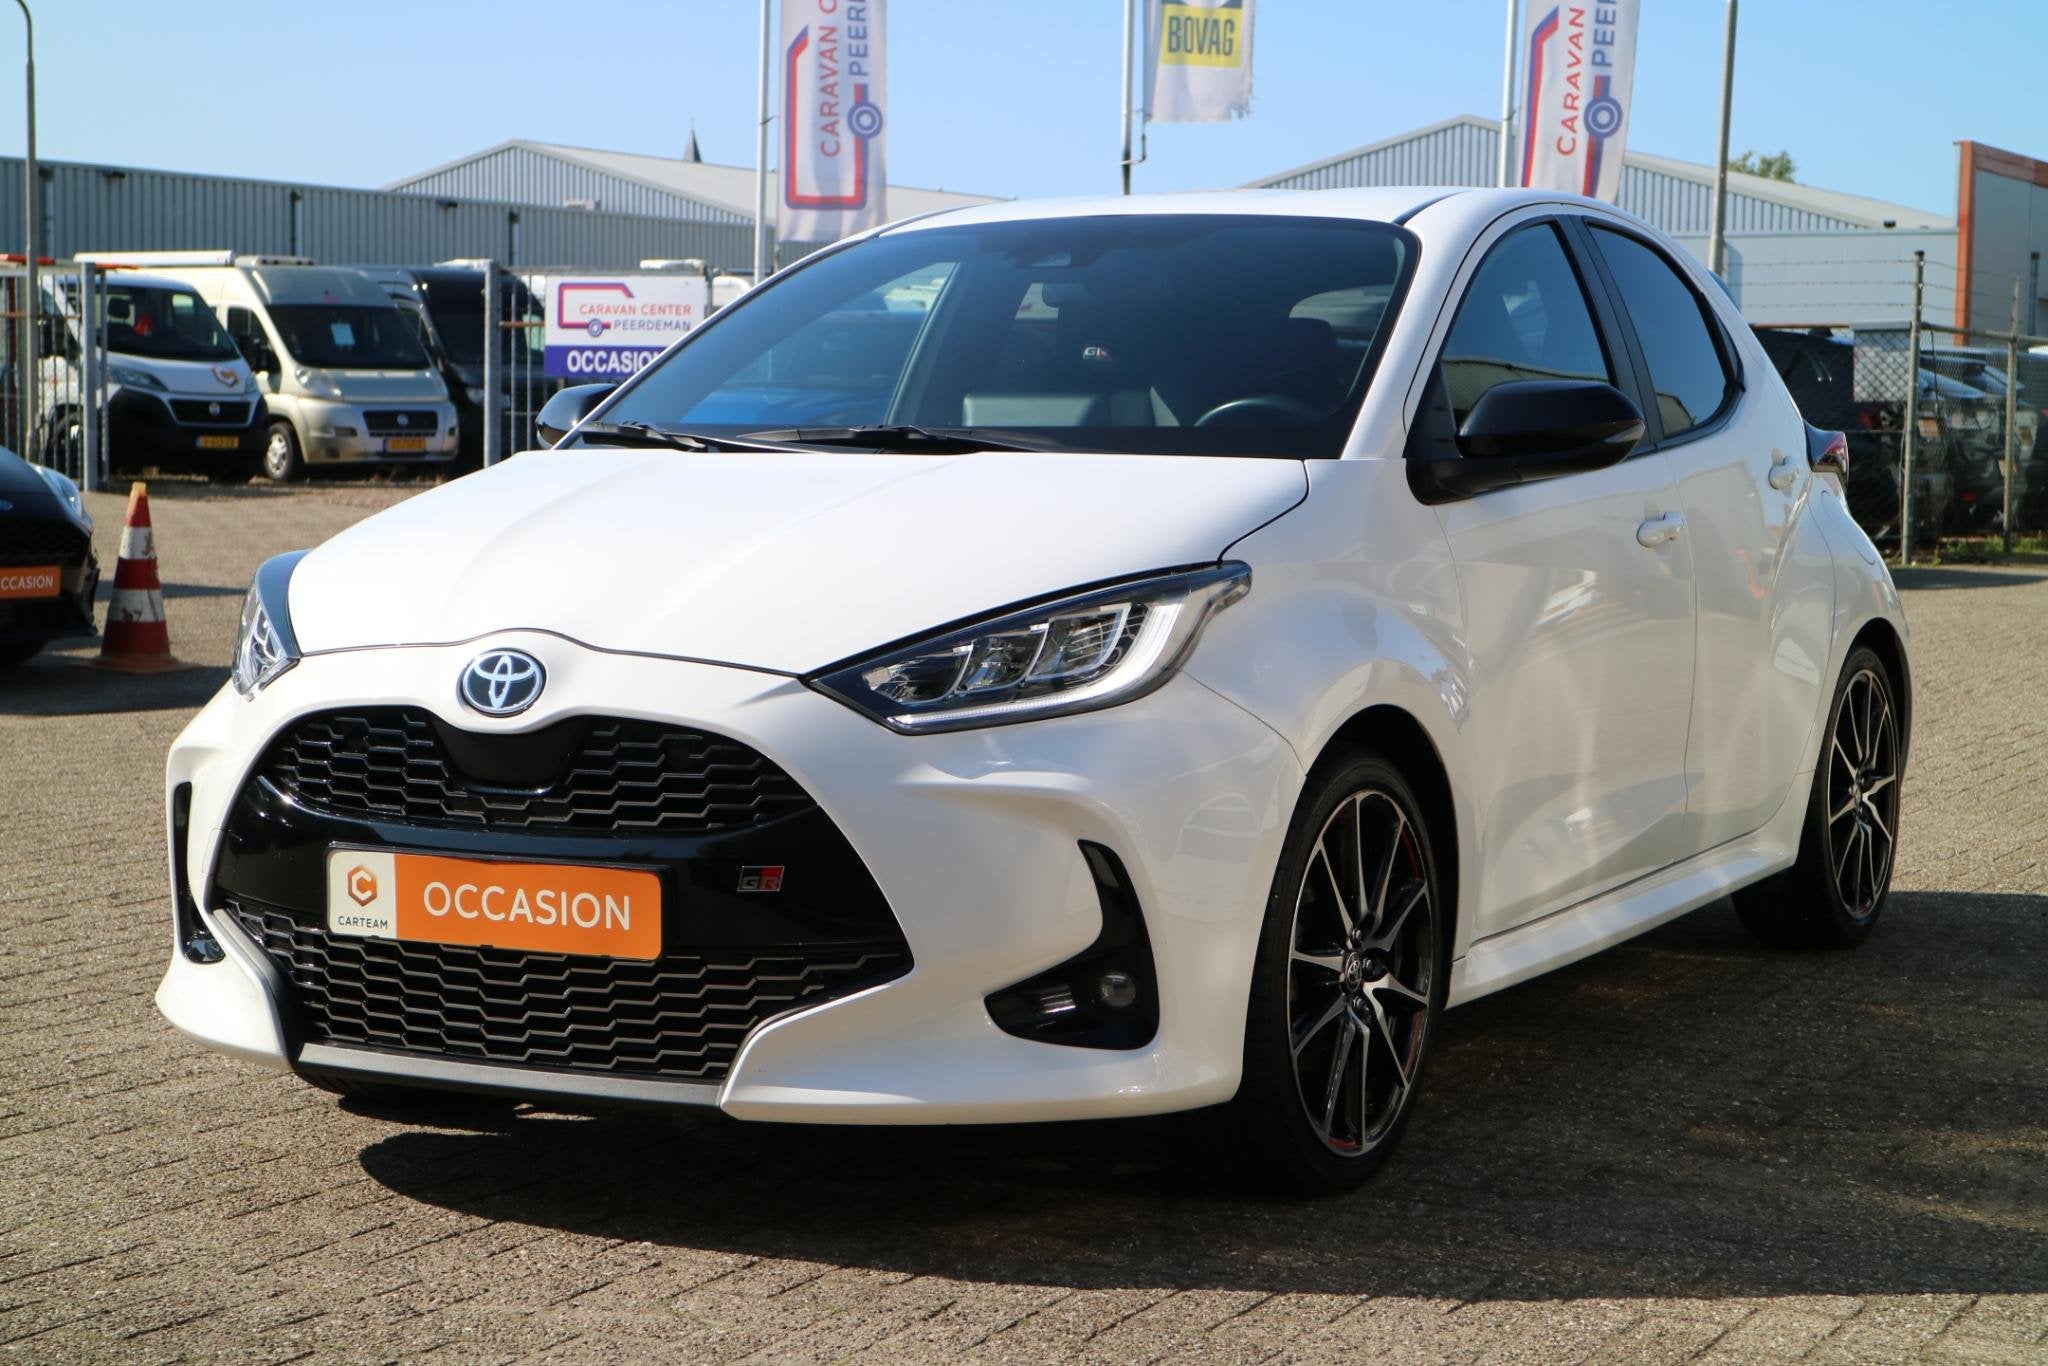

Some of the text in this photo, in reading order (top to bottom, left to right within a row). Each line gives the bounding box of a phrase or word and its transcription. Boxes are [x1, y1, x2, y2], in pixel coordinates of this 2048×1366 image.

[848, 0, 869, 77] PEER
[1168, 15, 1235, 56] BOVAG
[818, 26, 841, 158] CARAVAN
[1556, 7, 1586, 156] CARAVAN
[579, 303, 692, 316] CARAVAN CENTER
[614, 319, 692, 332] PEERDEMAN
[567, 350, 661, 373] OCCASIO
[337, 915, 389, 930] CARTEAM
[423, 881, 631, 931] OCCASION
